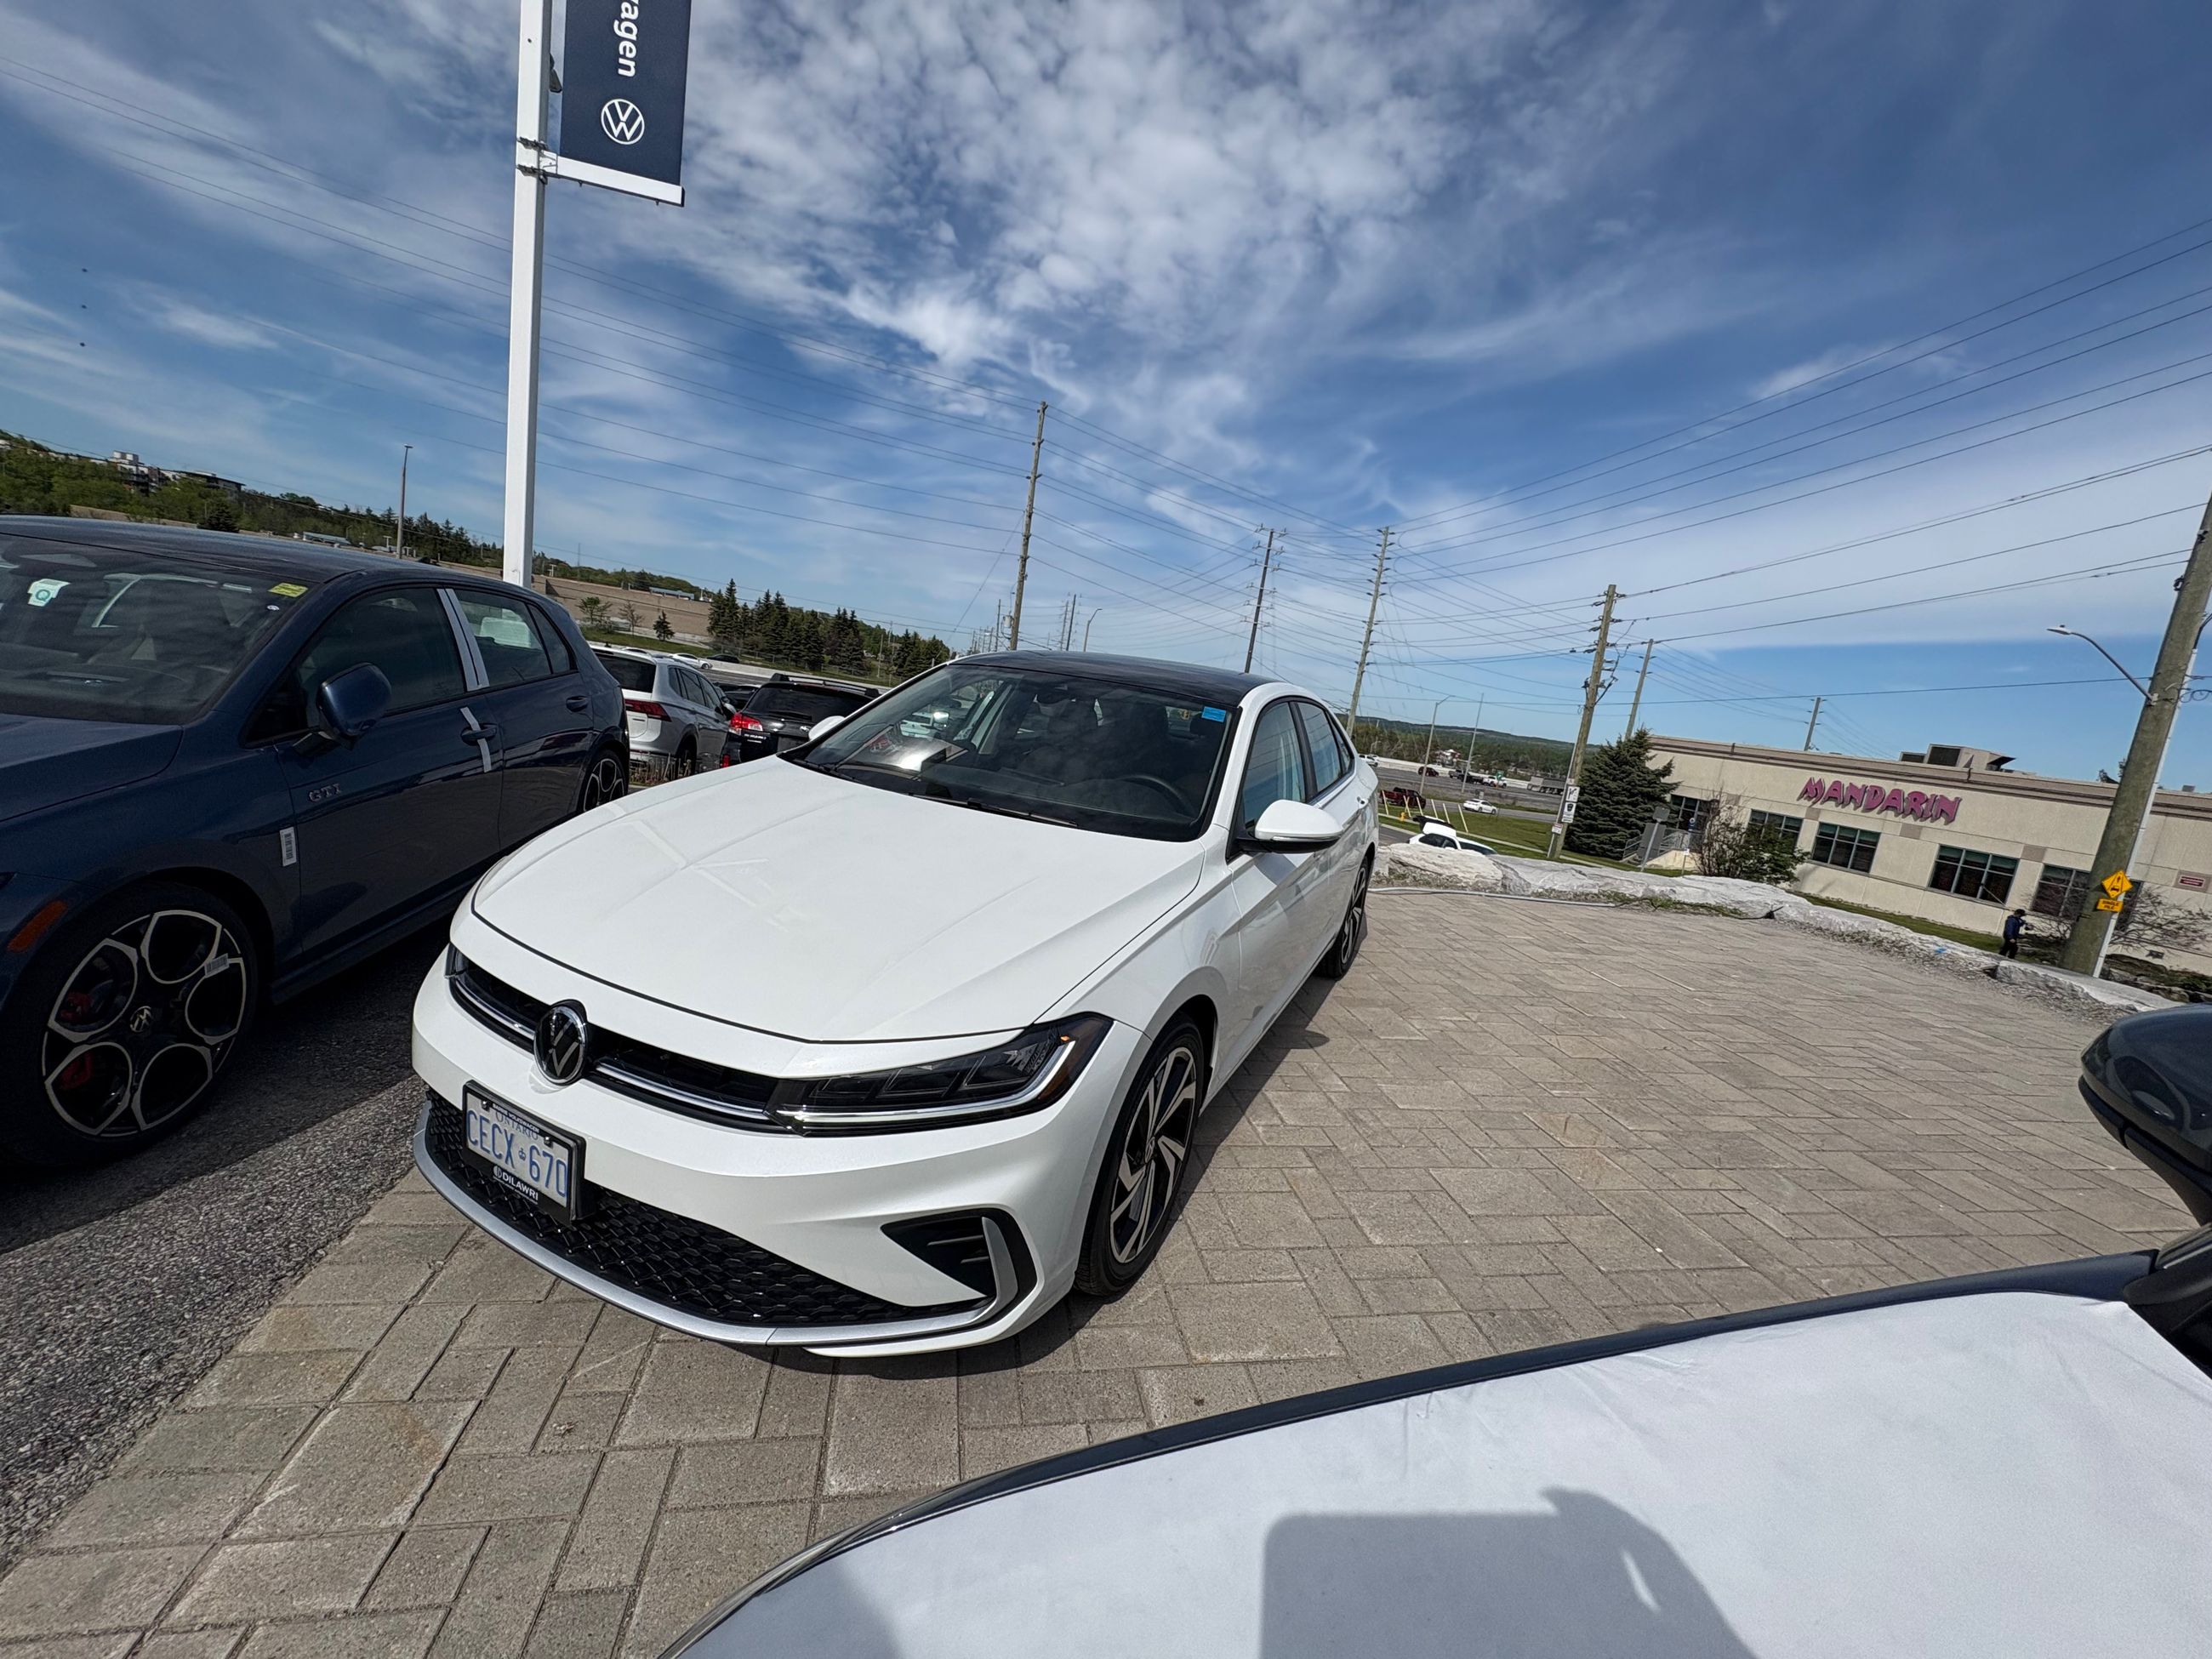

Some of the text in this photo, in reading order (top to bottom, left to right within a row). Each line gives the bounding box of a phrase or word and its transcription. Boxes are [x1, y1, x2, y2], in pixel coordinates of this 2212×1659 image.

[613, 0, 640, 77] agen
[309, 784, 342, 801] GTI
[1798, 778, 1961, 823] MANDARIN
[496, 1111, 539, 1141] ONTARIO
[508, 1113, 540, 1133] VOLKSWAGEN
[466, 1109, 515, 1169] CECX
[528, 1144, 568, 1200] 670
[502, 1172, 539, 1201] DILAWRI
